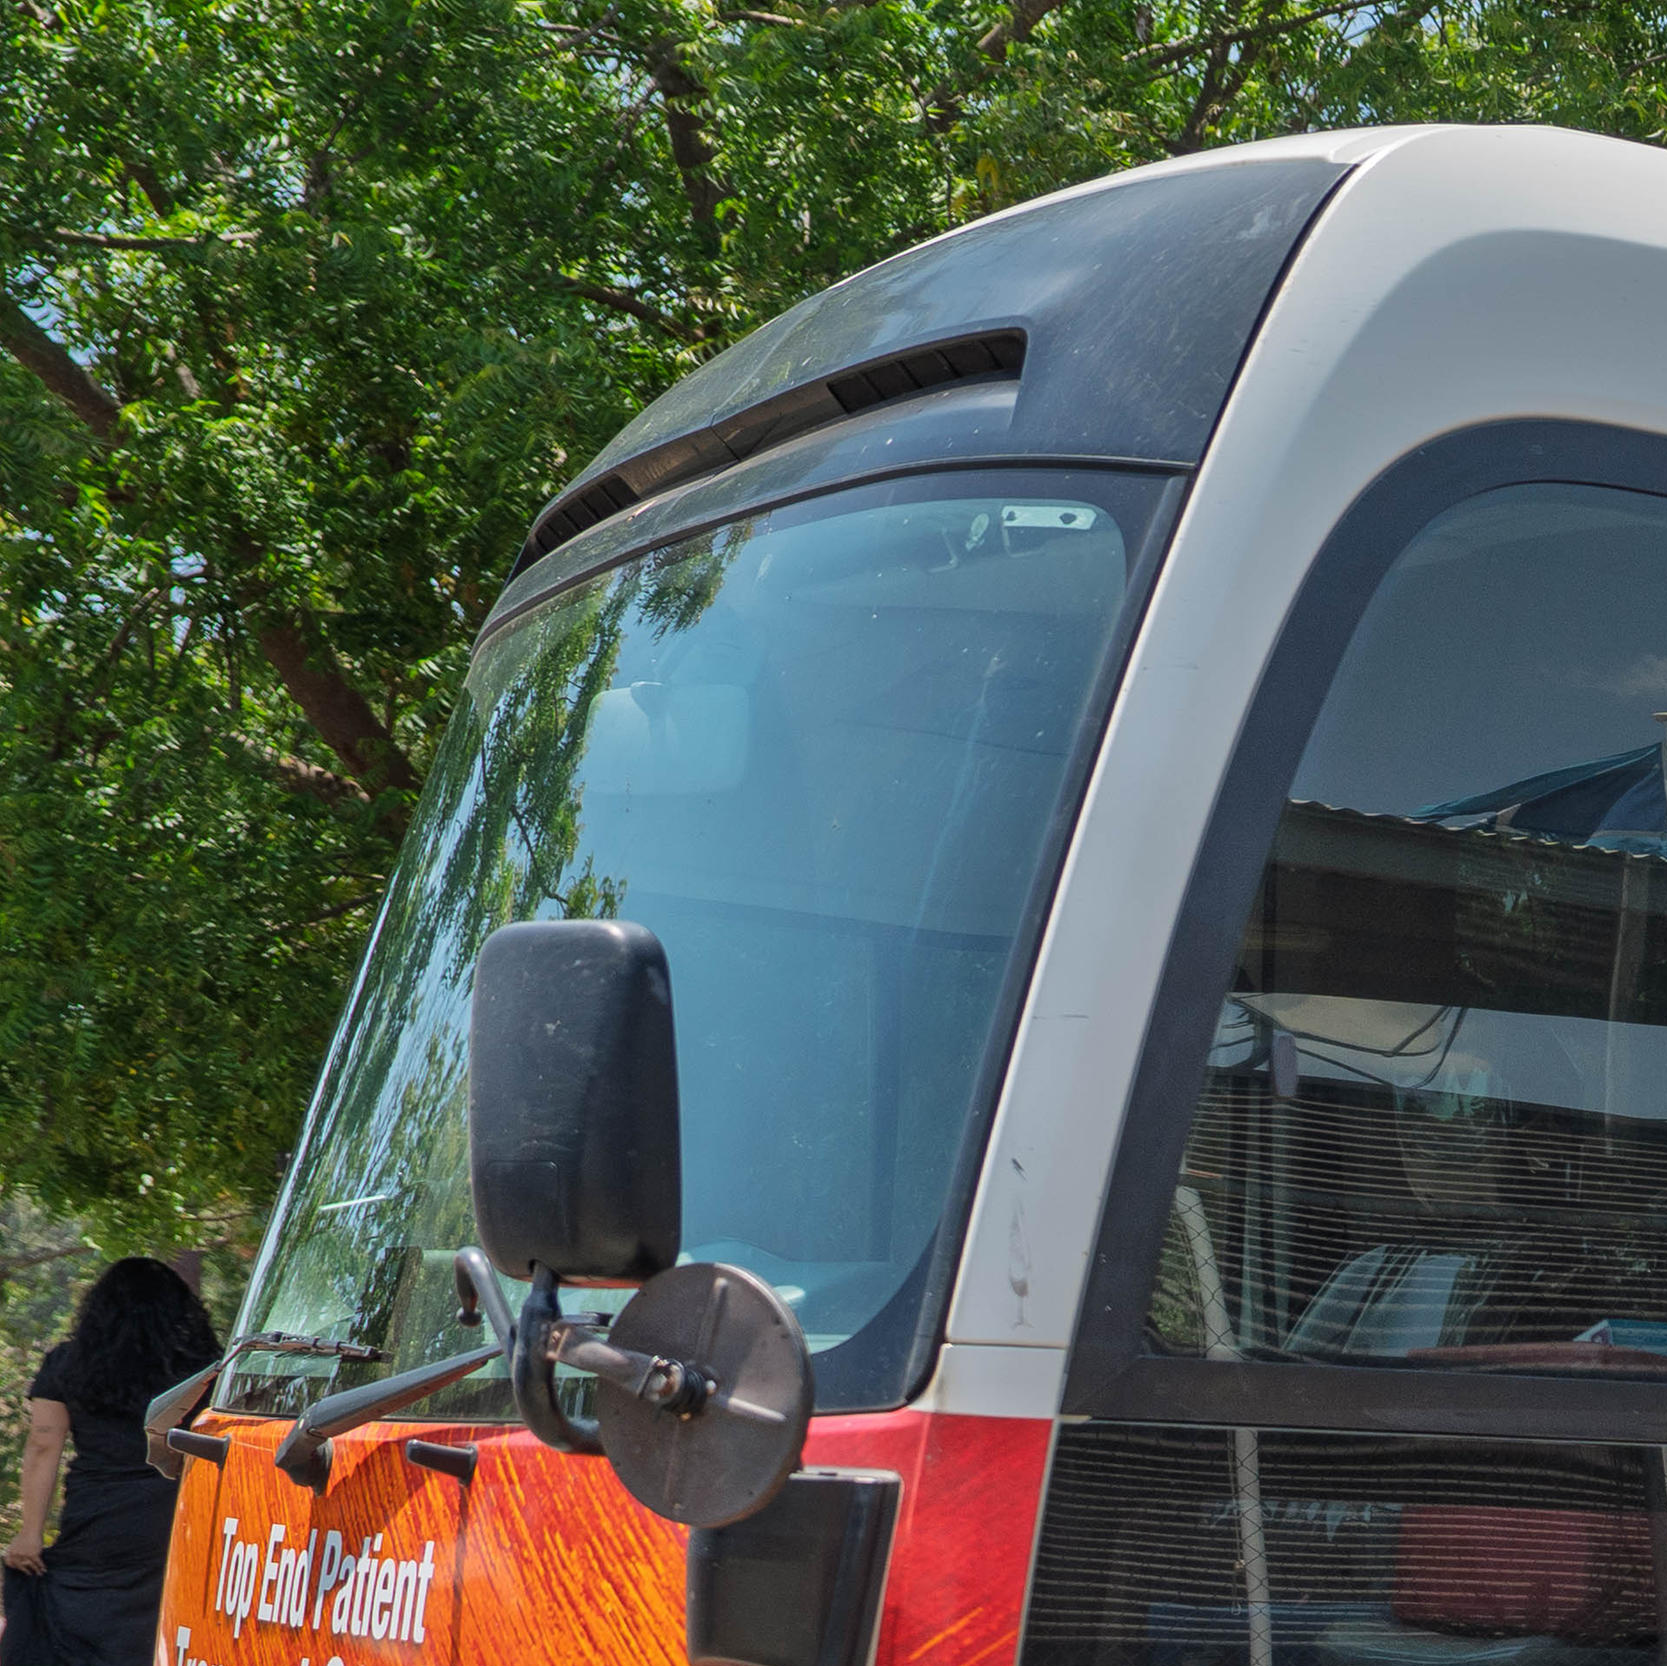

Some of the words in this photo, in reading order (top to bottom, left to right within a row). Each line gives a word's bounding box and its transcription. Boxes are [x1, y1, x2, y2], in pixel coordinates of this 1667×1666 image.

[213, 1517, 259, 1638] Top
[257, 1524, 317, 1629] End
[312, 1529, 434, 1645] Patient
